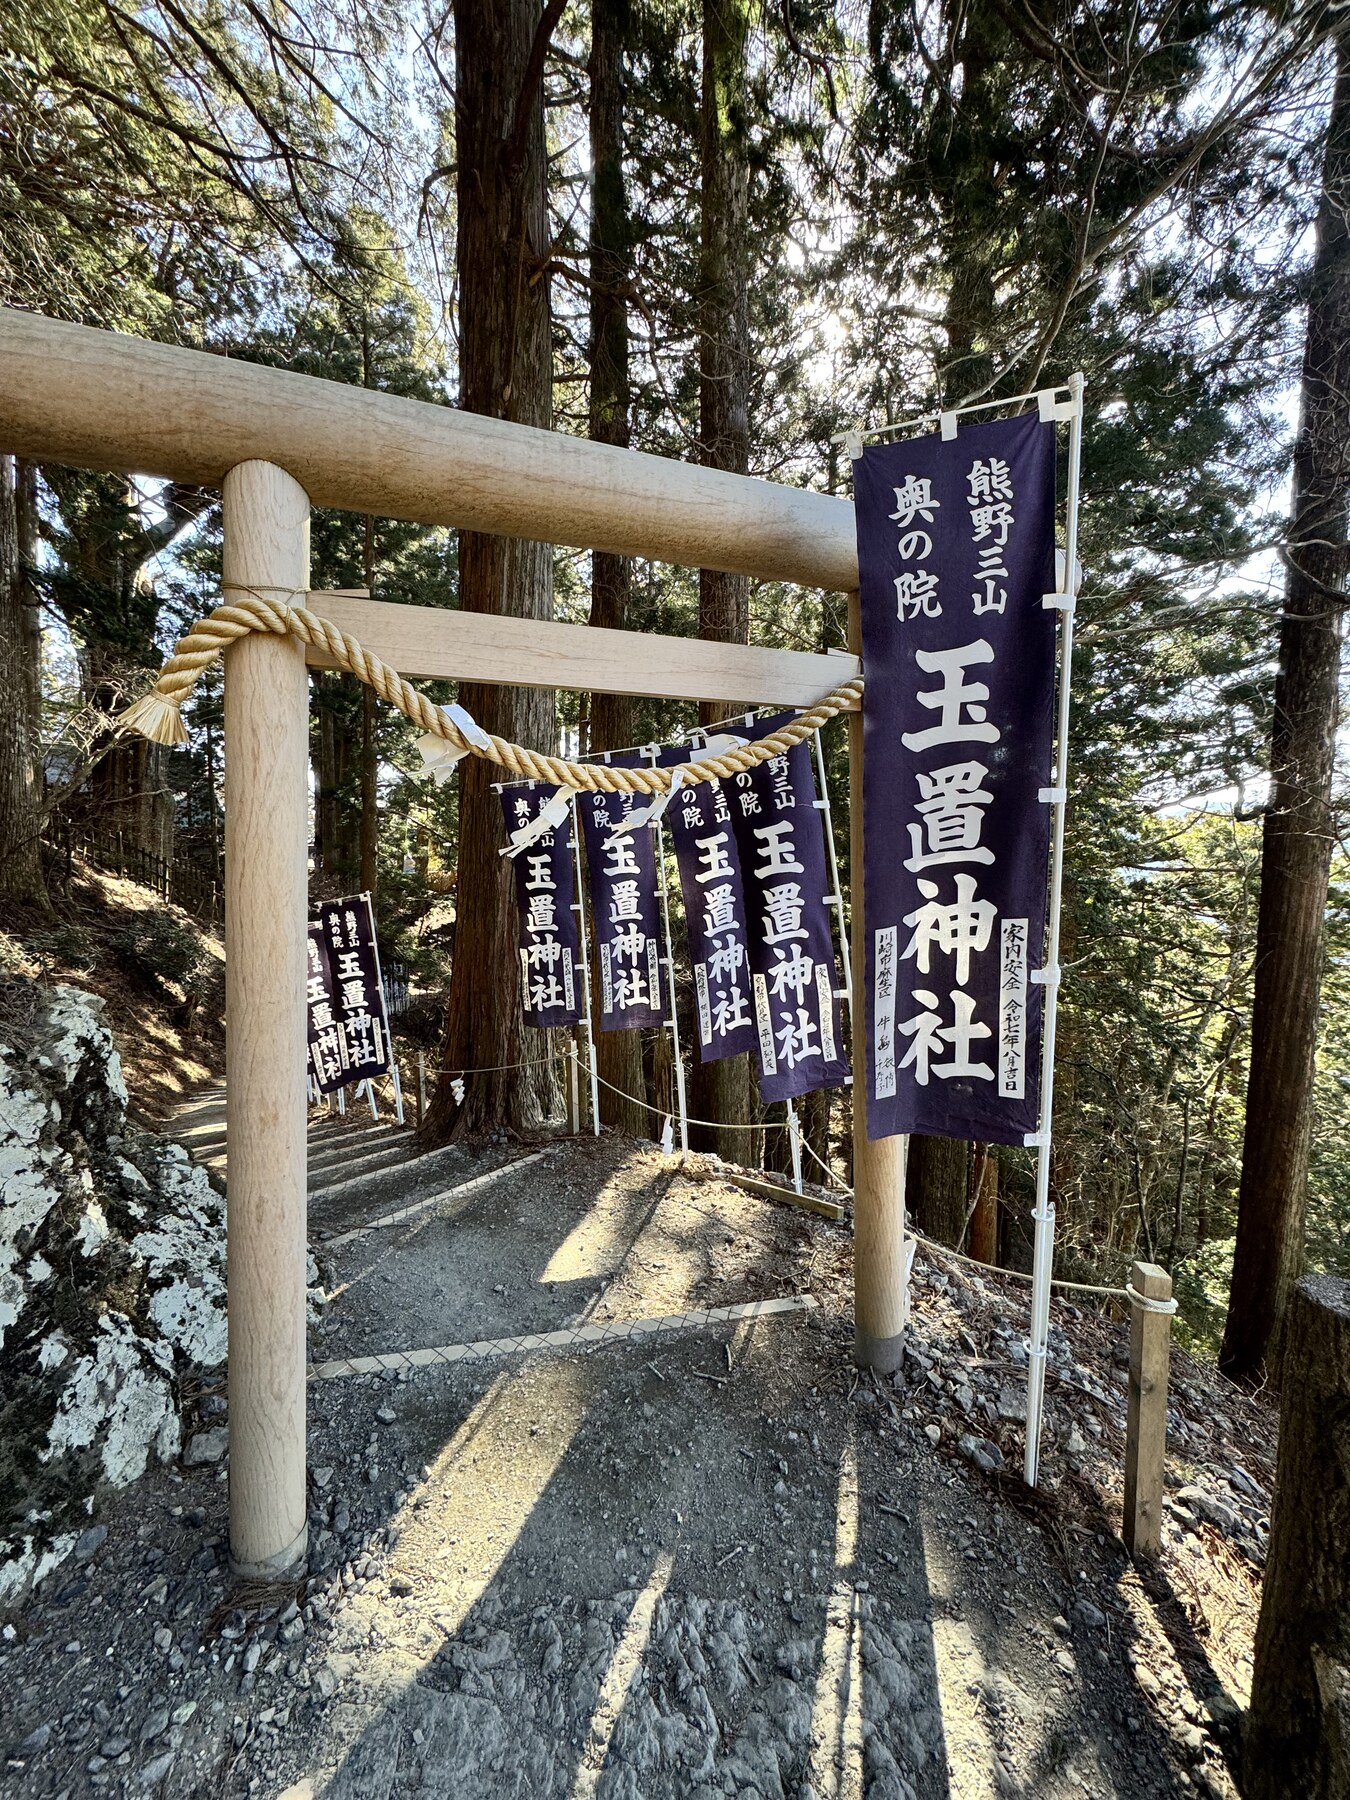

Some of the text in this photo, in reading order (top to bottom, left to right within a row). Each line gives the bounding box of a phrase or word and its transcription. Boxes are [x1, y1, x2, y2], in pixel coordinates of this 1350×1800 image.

[887, 474, 943, 623] 奥の院
[965, 457, 1015, 617] 熊野三山
[592, 788, 612, 829] の院
[680, 779, 704, 829] の院
[768, 751, 796, 810] 野三山
[328, 912, 344, 949] 奥の院
[344, 910, 360, 948] 熊野三山
[525, 853, 566, 1012] 玉置神社
[601, 834, 650, 1011] 玉置神社
[694, 831, 752, 1037] 玉置神社
[898, 638, 999, 1087] 玉置神社
[338, 951, 376, 1068] 玉置神社
[753, 821, 821, 1069] 玉置神社
[1001, 922, 1026, 1092] 家内安全 令和七年八月吉日
